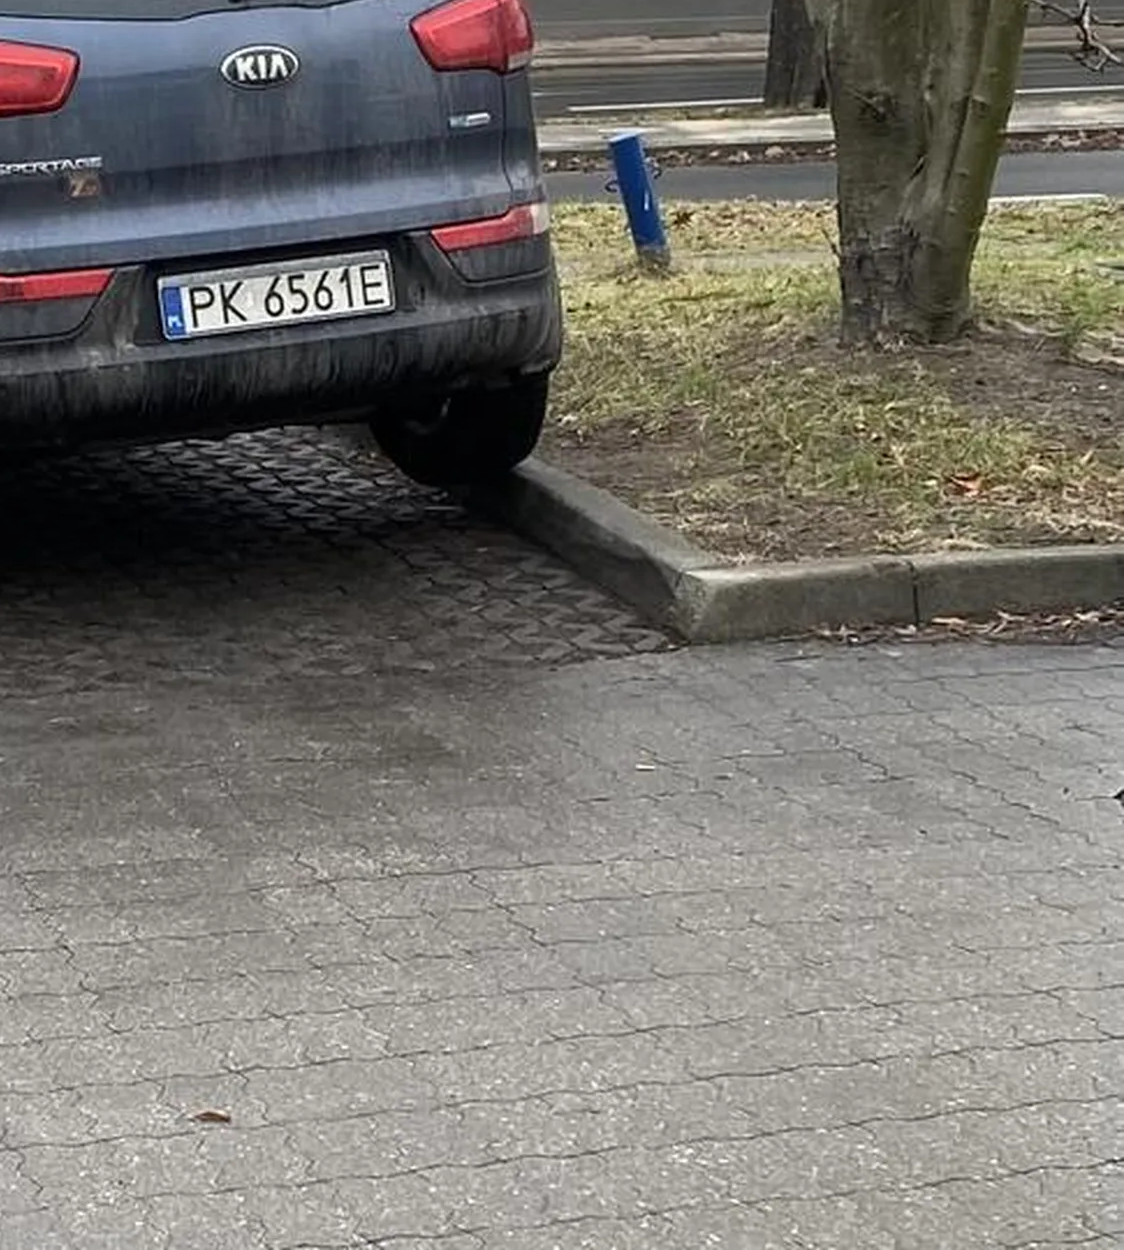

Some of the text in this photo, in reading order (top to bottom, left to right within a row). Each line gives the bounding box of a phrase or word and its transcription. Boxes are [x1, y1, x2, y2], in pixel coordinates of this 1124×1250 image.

[236, 54, 289, 81] KIA
[188, 265, 385, 328] PK 6561E
